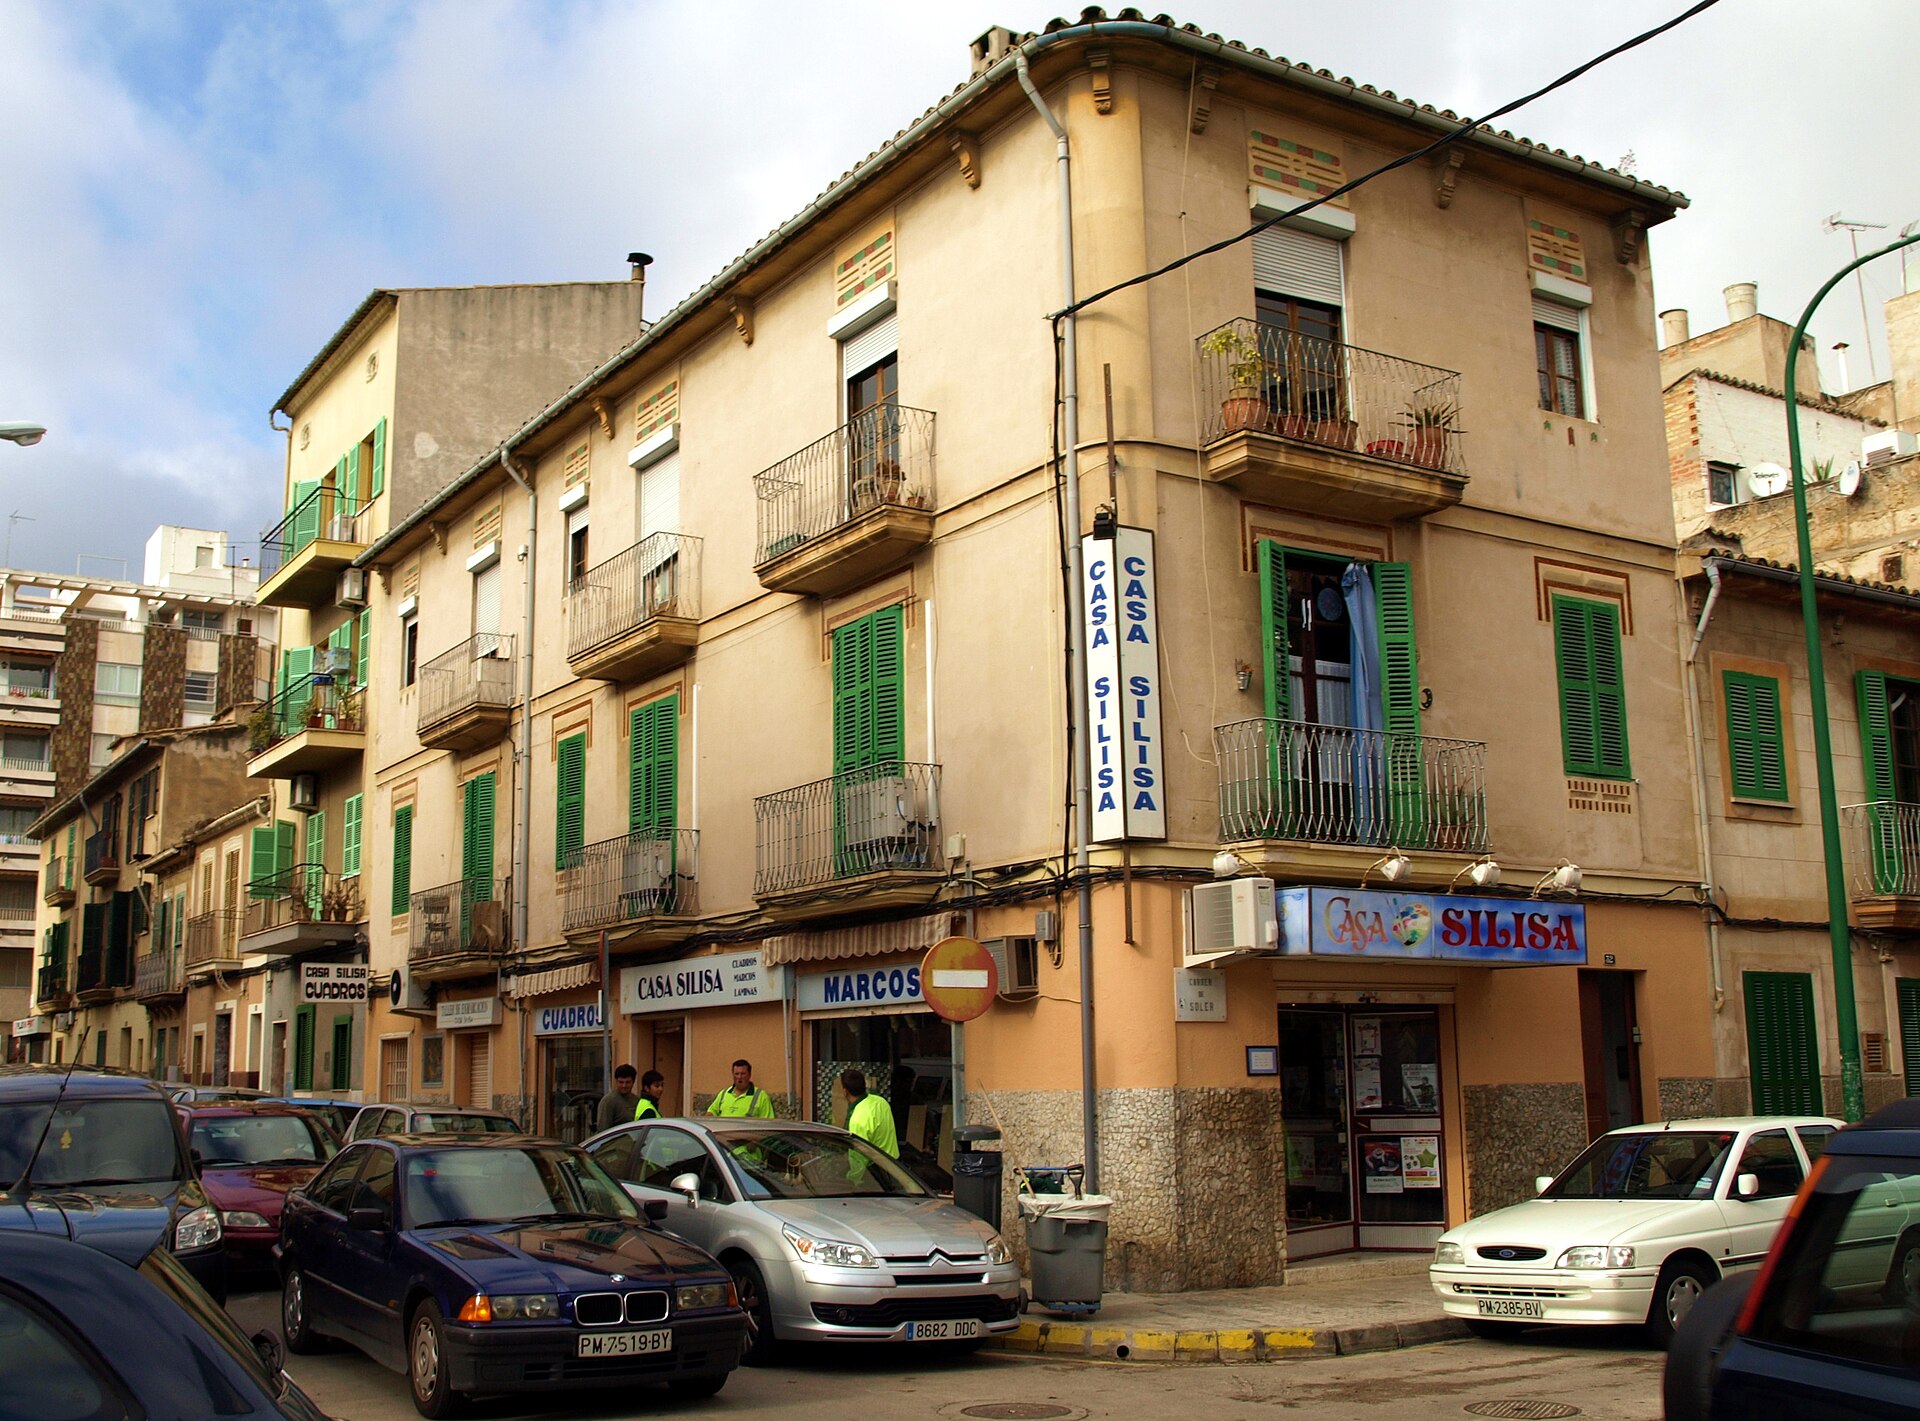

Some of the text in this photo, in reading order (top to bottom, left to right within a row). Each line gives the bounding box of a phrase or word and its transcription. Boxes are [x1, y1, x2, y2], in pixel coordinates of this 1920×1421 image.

[1089, 560, 1116, 812] CASA SILISA
[1124, 556, 1157, 812] CASA SILISA
[1324, 896, 1580, 951] CASA SILISA
[305, 966, 367, 978] CASA SILISA
[638, 968, 724, 1000] CASA SILISA
[824, 967, 920, 1004] MARCOS
[305, 982, 366, 999] CUADROS
[916, 1321, 977, 1338] 8682 DDC
